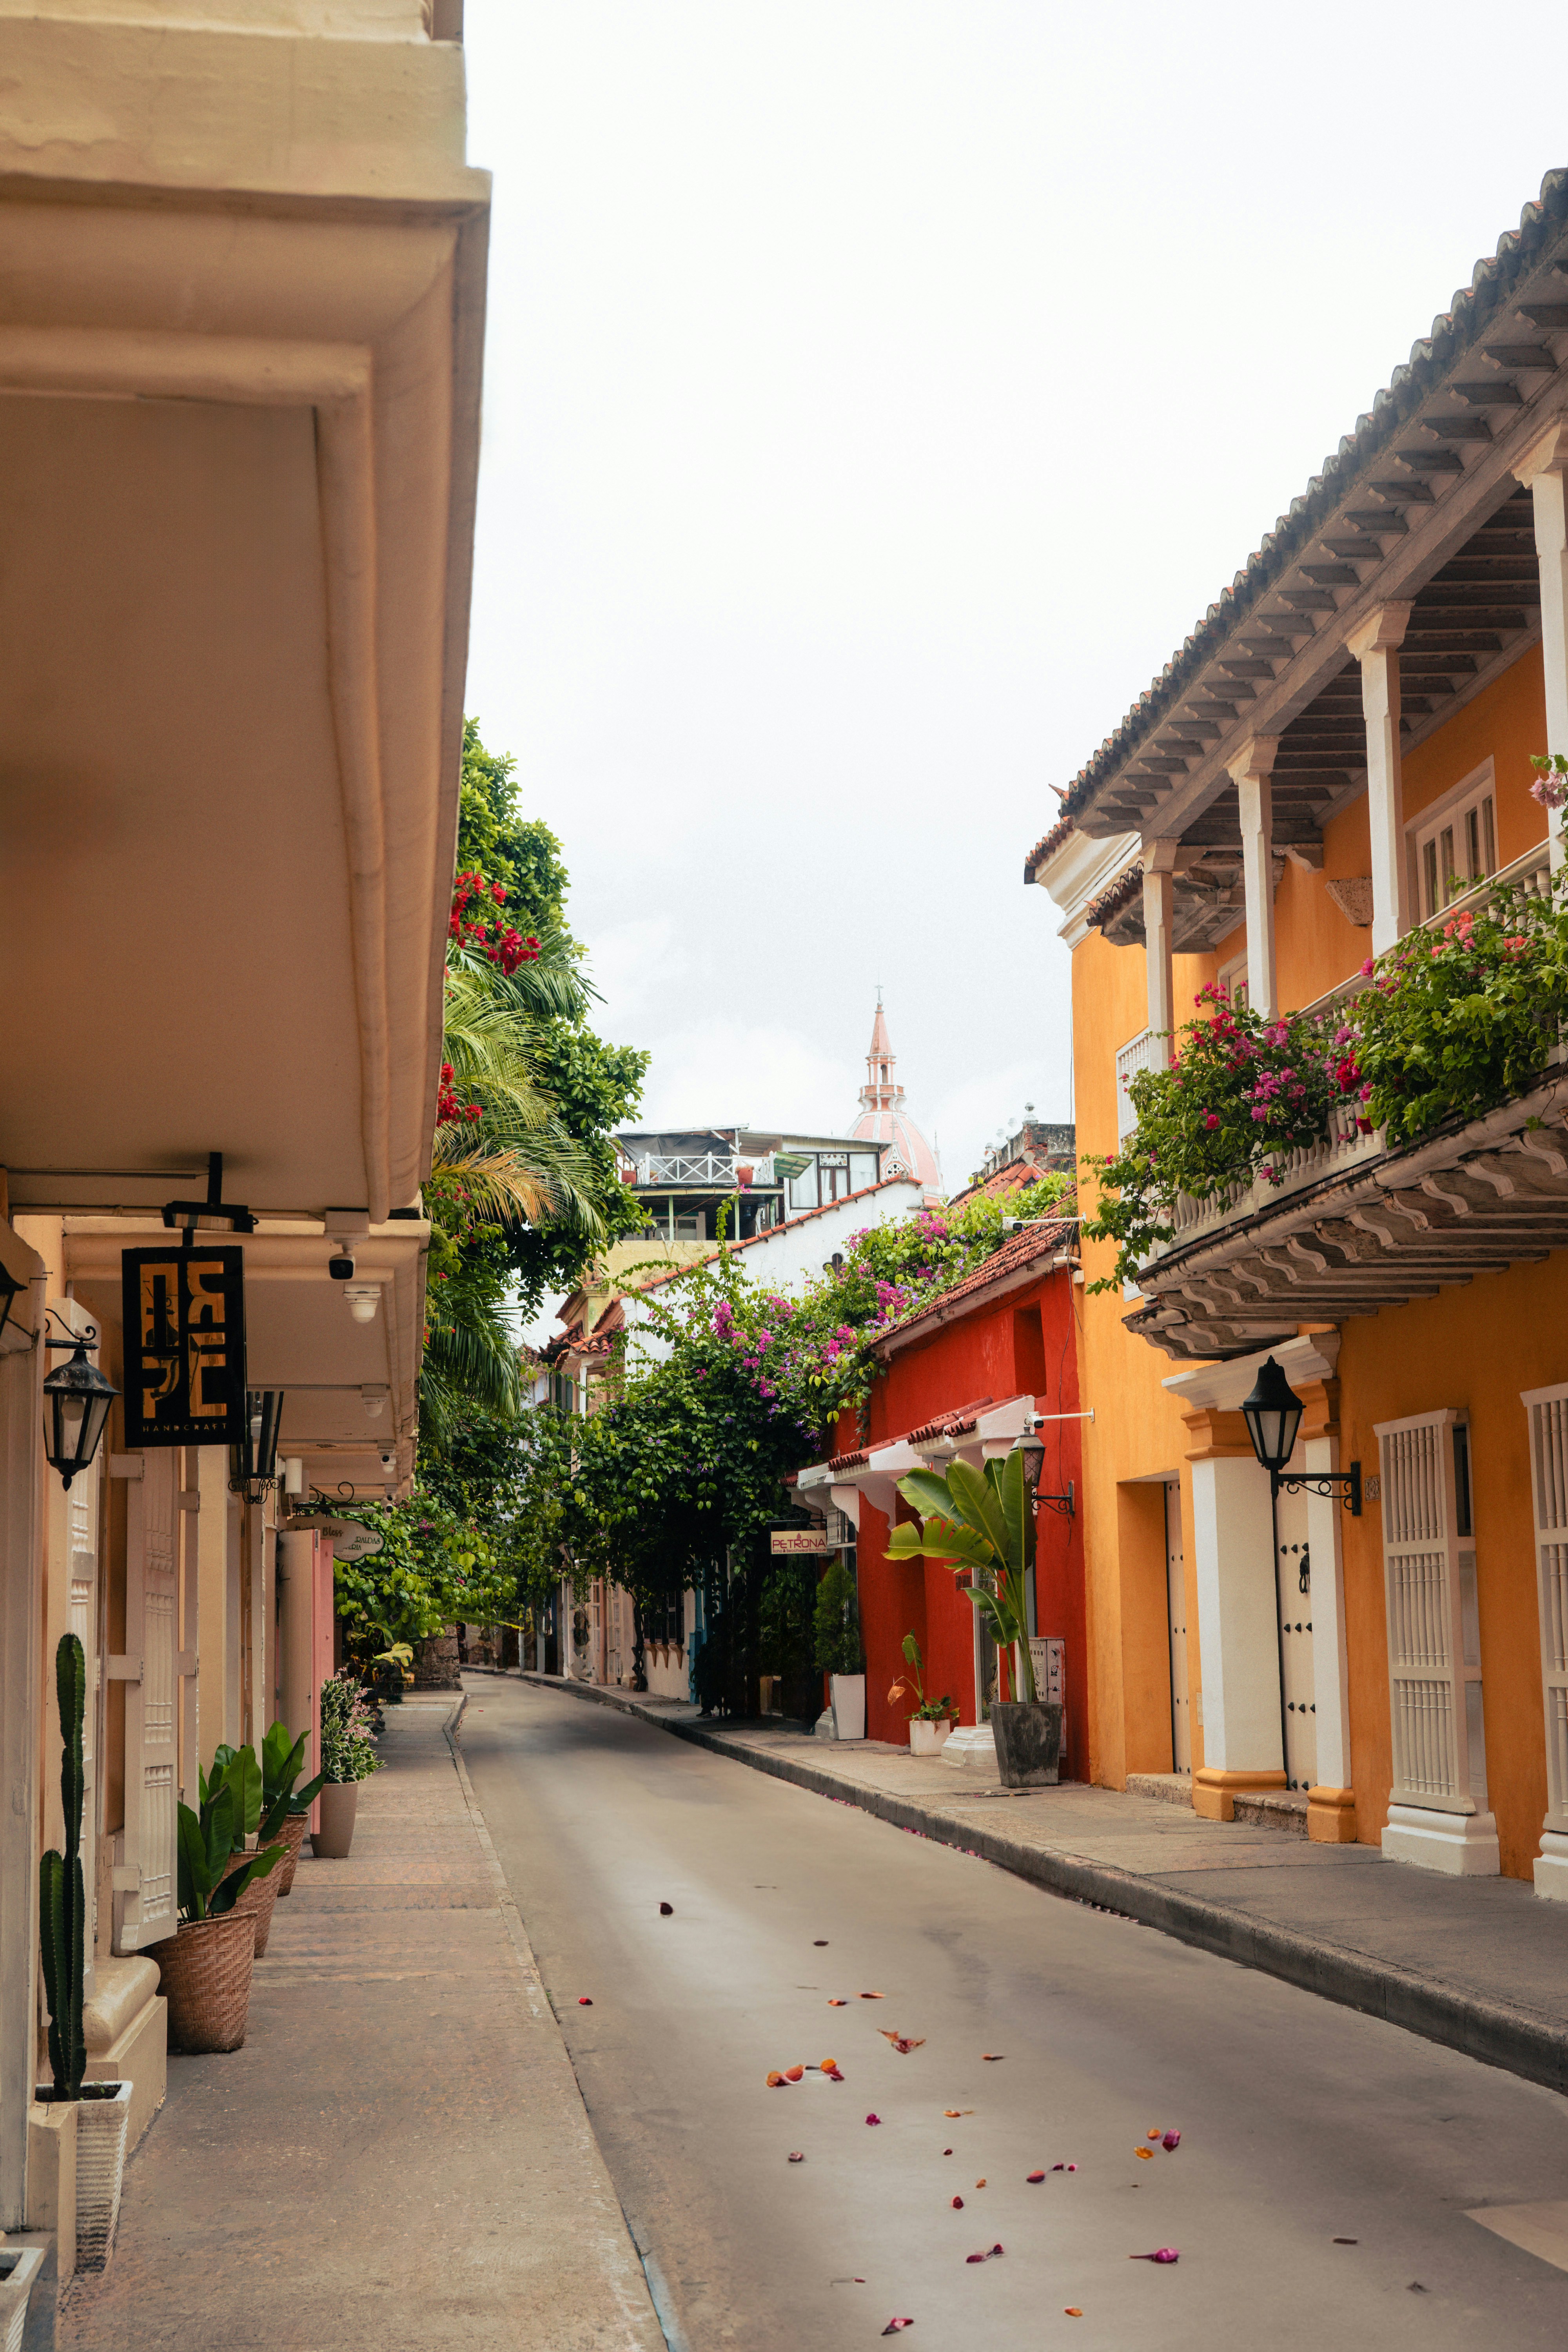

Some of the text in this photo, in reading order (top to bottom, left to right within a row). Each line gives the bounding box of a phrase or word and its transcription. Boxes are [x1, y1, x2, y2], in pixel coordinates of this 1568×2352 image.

[143, 1423, 227, 1432] HANDCRAFT
[322, 1526, 344, 1537] Bless
[354, 1536, 381, 1544] RALDAS
[773, 1538, 826, 1548] PETRONA
